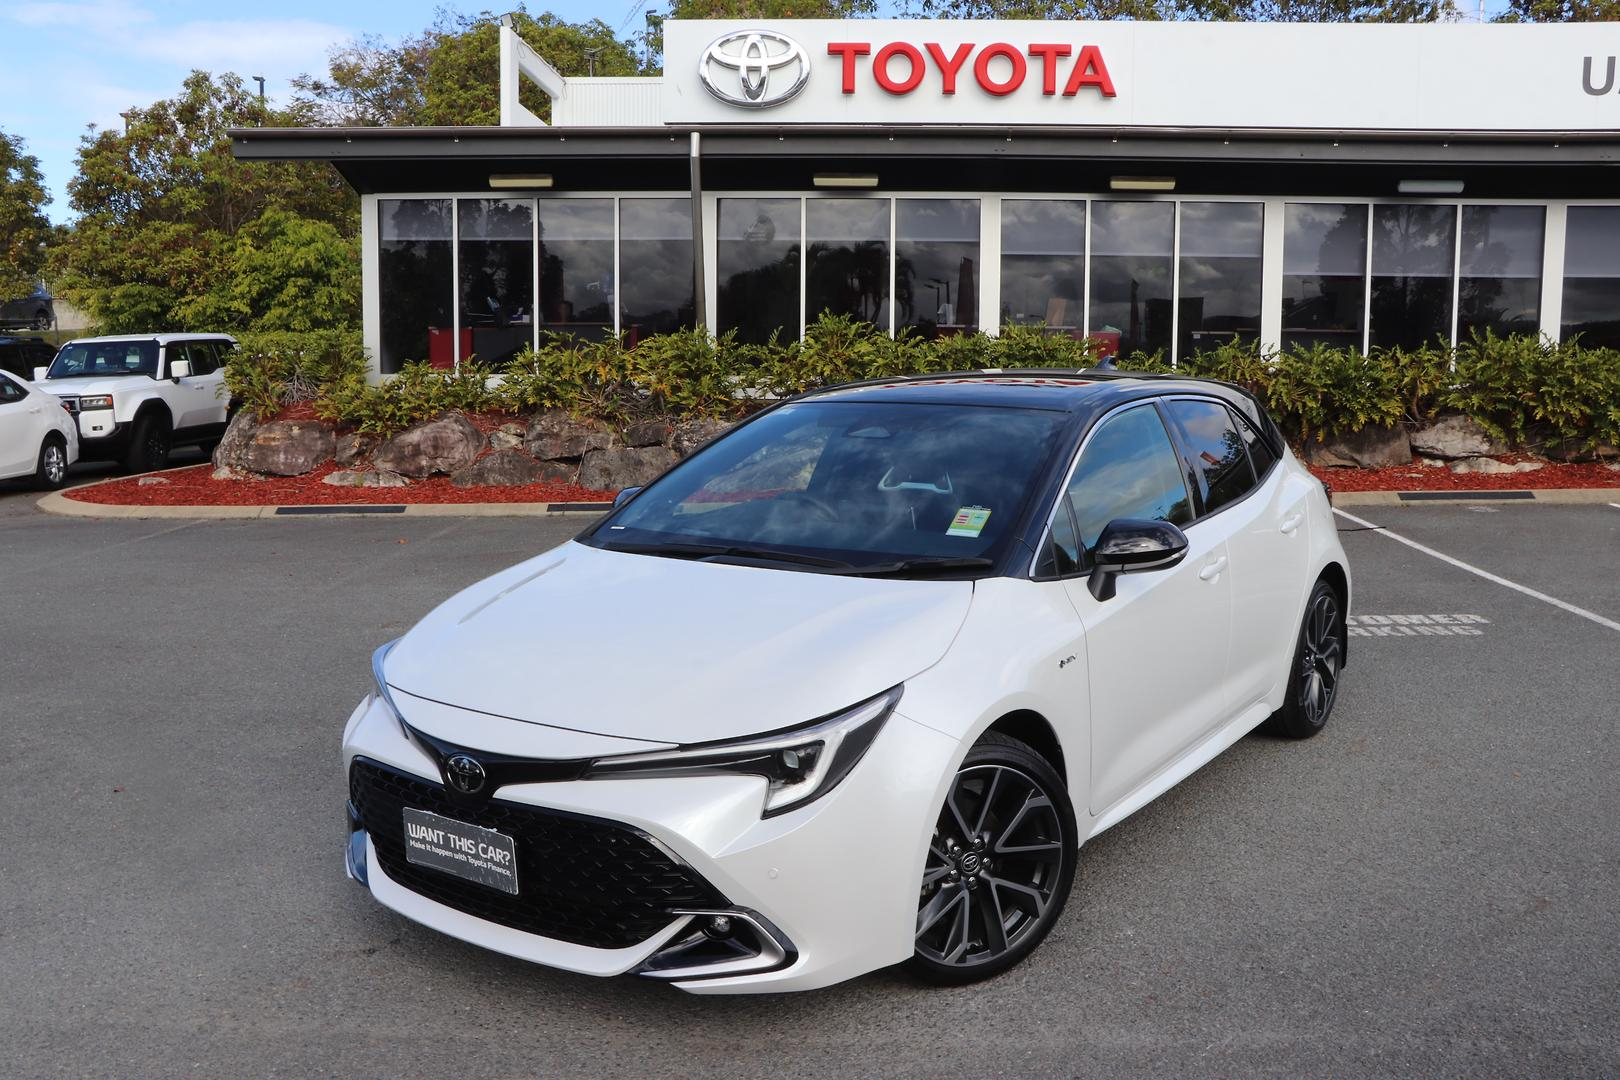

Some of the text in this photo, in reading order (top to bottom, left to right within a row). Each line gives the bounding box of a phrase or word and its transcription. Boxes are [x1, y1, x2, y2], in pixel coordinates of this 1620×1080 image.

[827, 41, 1117, 97] TOYOTA
[1582, 56, 1620, 96] U
[407, 822, 445, 845] WANT
[447, 833, 476, 854] THIS
[478, 843, 511, 866] CAR?
[409, 839, 426, 849] Make
[426, 843, 432, 852] it
[431, 845, 454, 857] happen
[453, 852, 468, 862] with
[467, 855, 487, 868] Toyota
